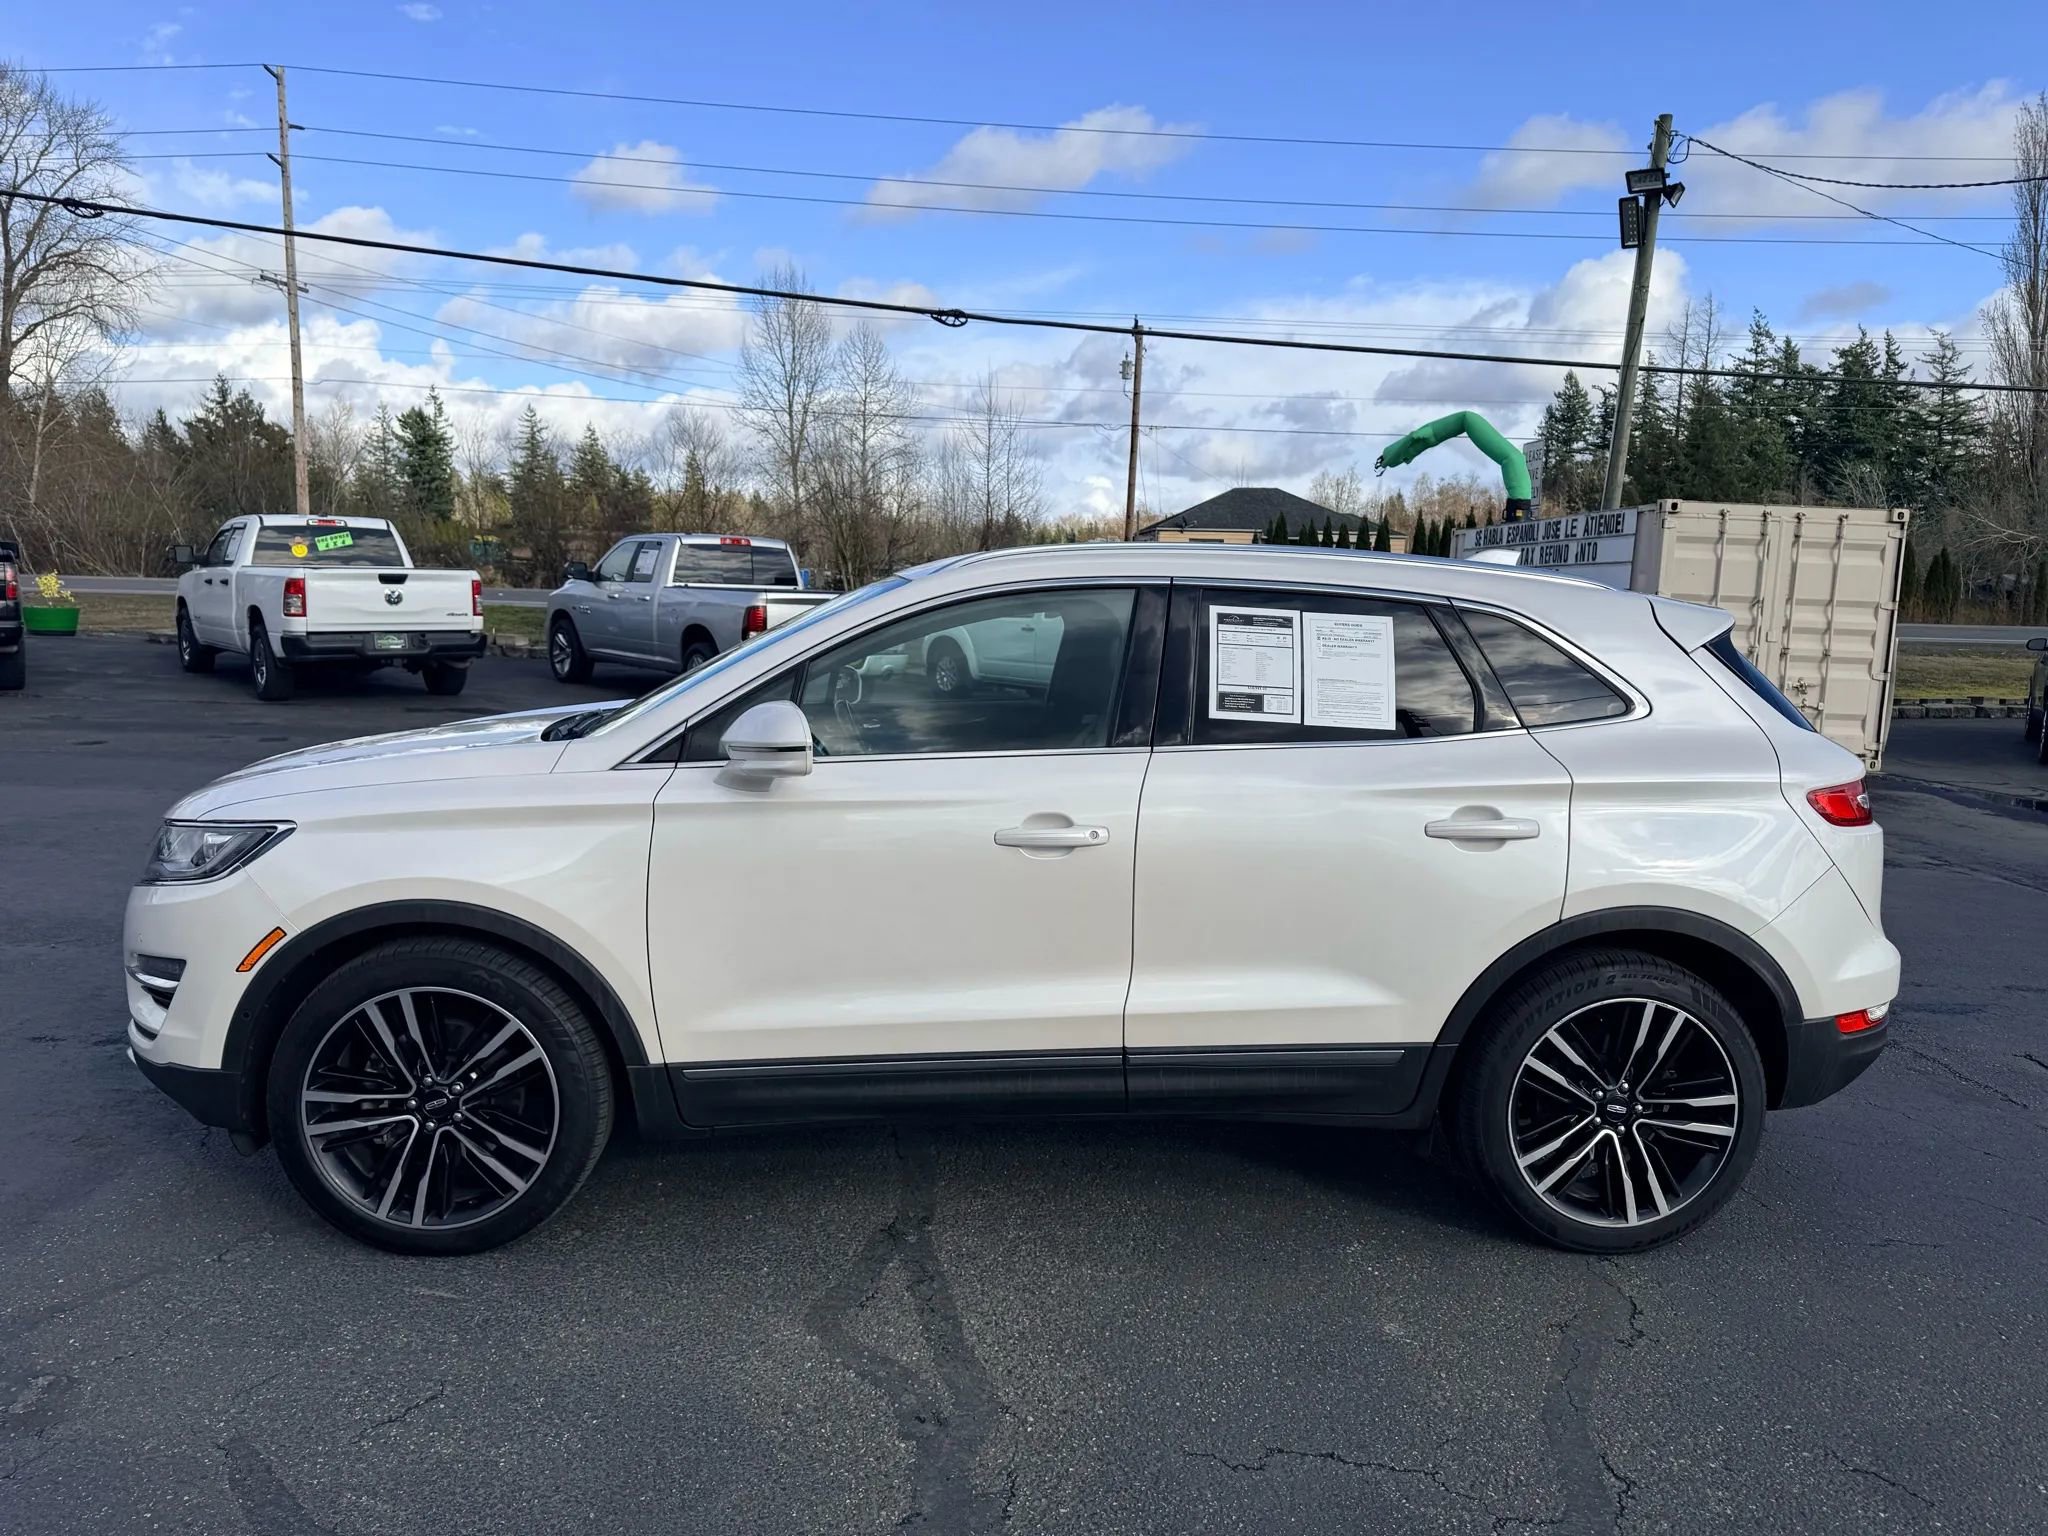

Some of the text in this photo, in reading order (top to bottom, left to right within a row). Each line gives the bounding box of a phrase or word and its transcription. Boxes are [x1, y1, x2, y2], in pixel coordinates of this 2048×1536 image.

[1475, 530, 1482, 547] SE
[1483, 527, 1503, 546] HABLA
[1542, 519, 1562, 540] JOSE
[1564, 518, 1578, 538] LE
[1583, 512, 1626, 537] ATIENDE!
[1519, 547, 1536, 566] TAX
[1539, 543, 1569, 565] REFUND
